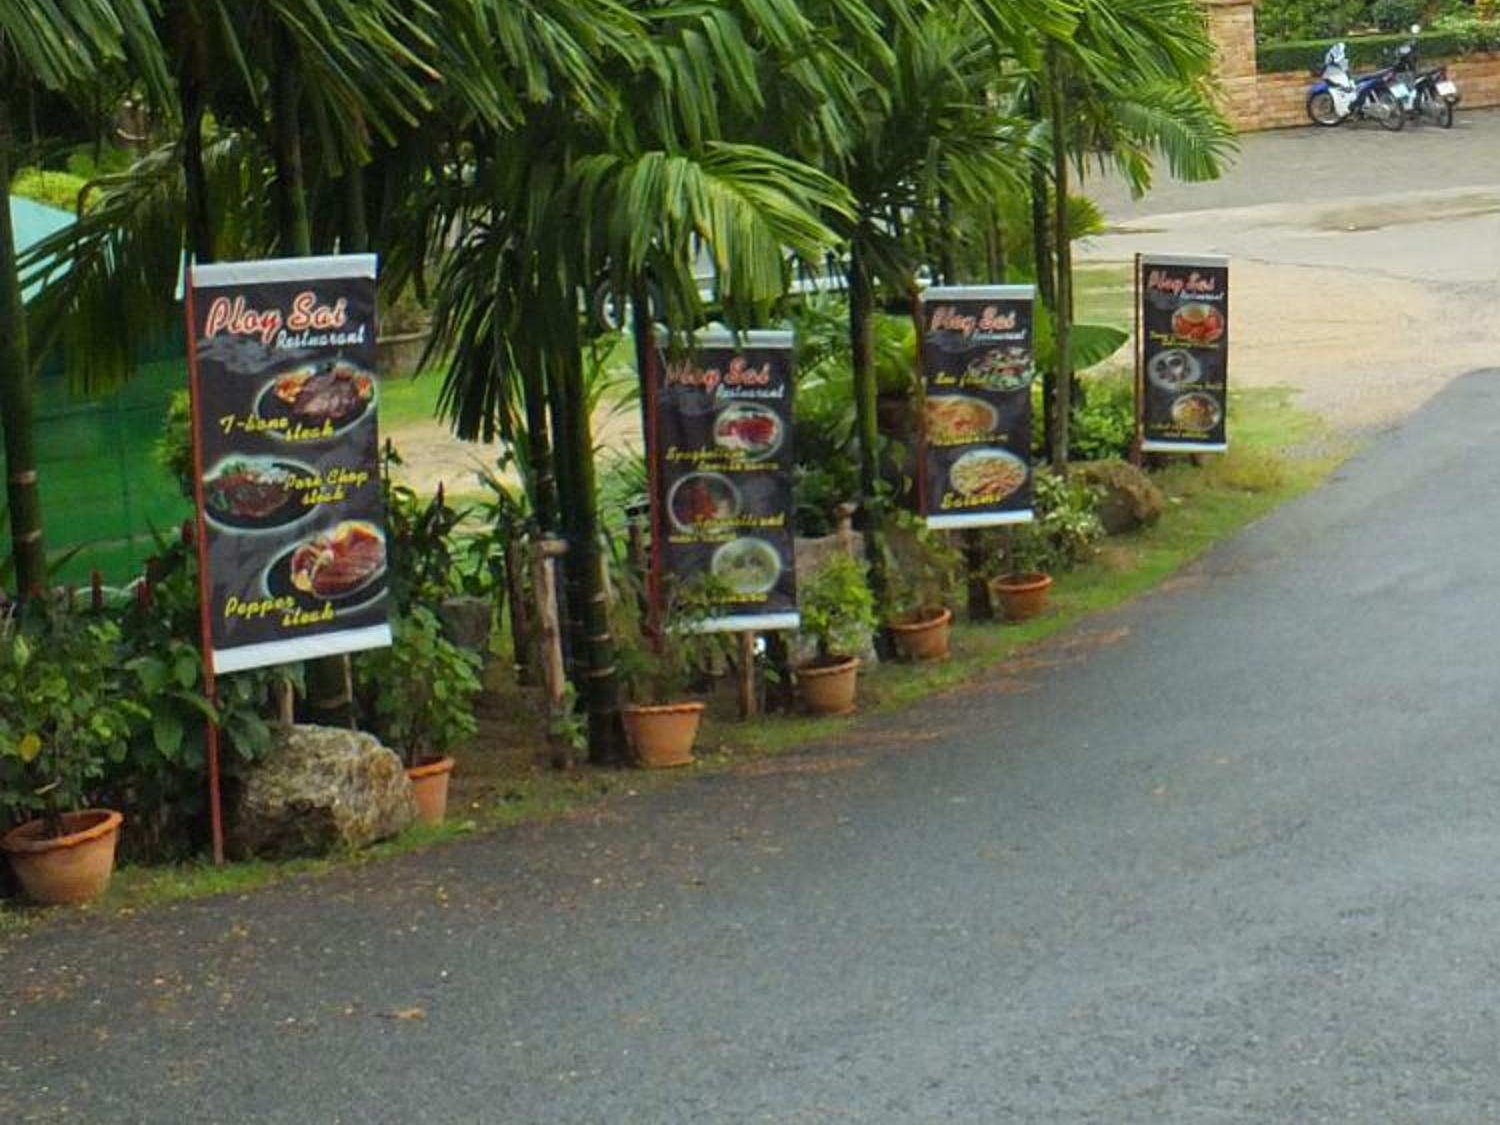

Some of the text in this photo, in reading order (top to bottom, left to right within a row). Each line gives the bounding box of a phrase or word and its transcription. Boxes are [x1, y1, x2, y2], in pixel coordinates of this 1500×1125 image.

[205, 290, 347, 344] Ploy Sai
[224, 595, 295, 618] Pepper
